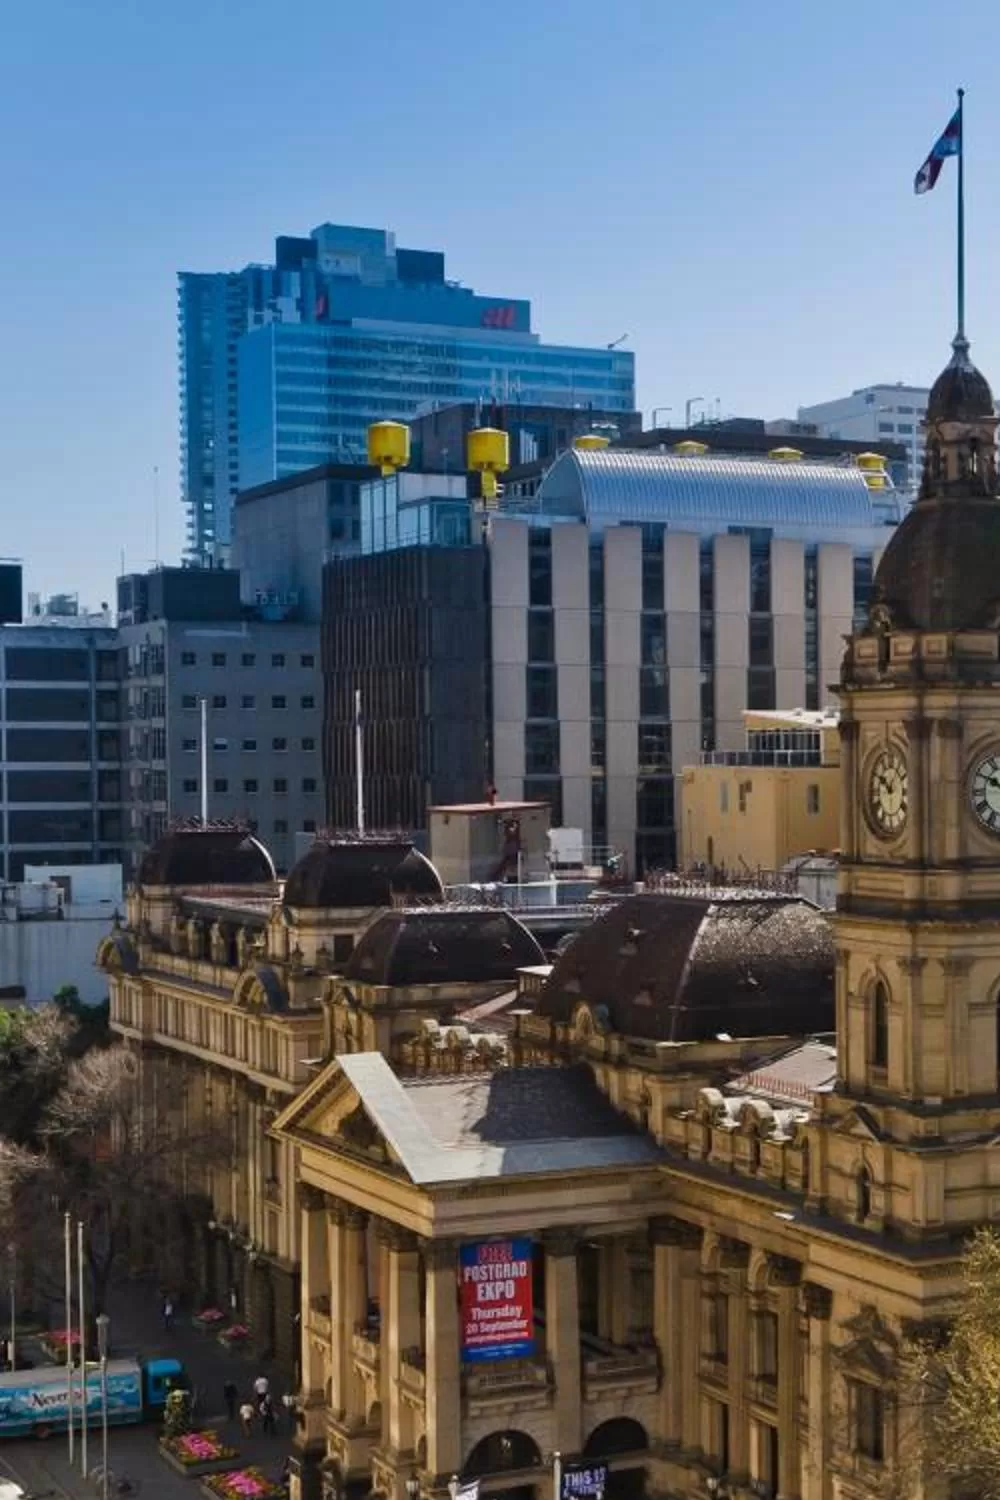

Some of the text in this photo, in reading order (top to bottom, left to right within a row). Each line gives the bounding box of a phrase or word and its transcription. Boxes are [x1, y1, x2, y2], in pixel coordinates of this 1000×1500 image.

[463, 1261, 528, 1283] POSTGRAD
[476, 1279, 516, 1302] EXPO
[471, 1305, 522, 1320] Thursday
[479, 1319, 529, 1333] September
[564, 1470, 592, 1487] THIS
